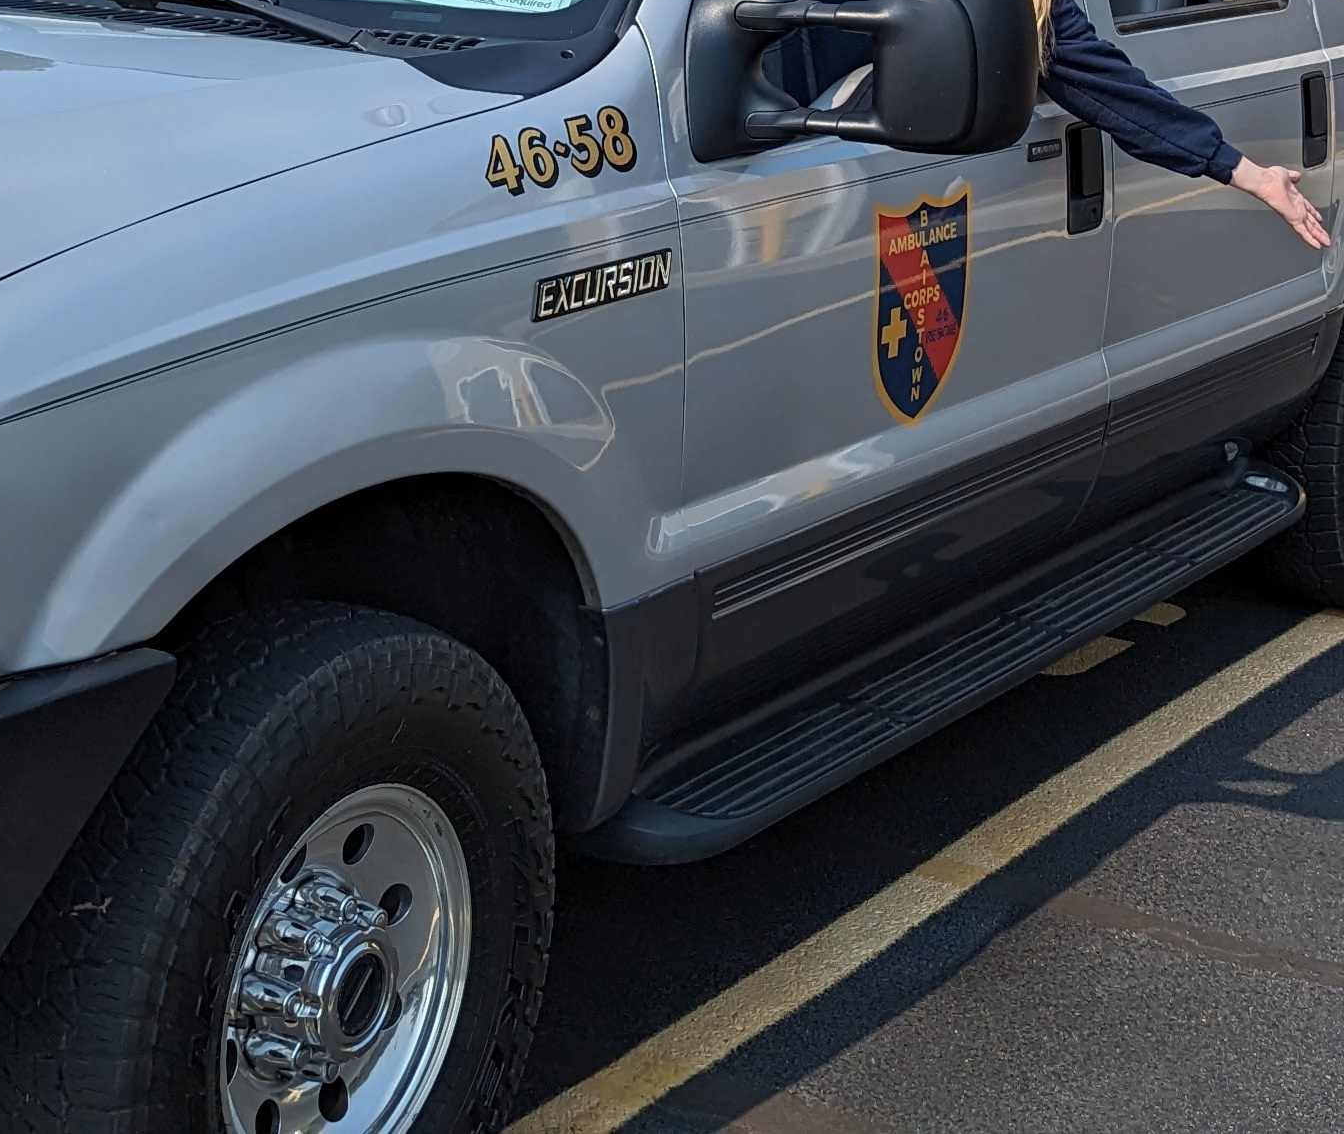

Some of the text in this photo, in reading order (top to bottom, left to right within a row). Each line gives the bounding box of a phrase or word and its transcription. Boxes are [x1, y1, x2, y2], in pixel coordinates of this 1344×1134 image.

[888, 222, 958, 256] AMBULANCE
[538, 251, 672, 318] EXCURSION
[903, 283, 940, 310] CORPS
